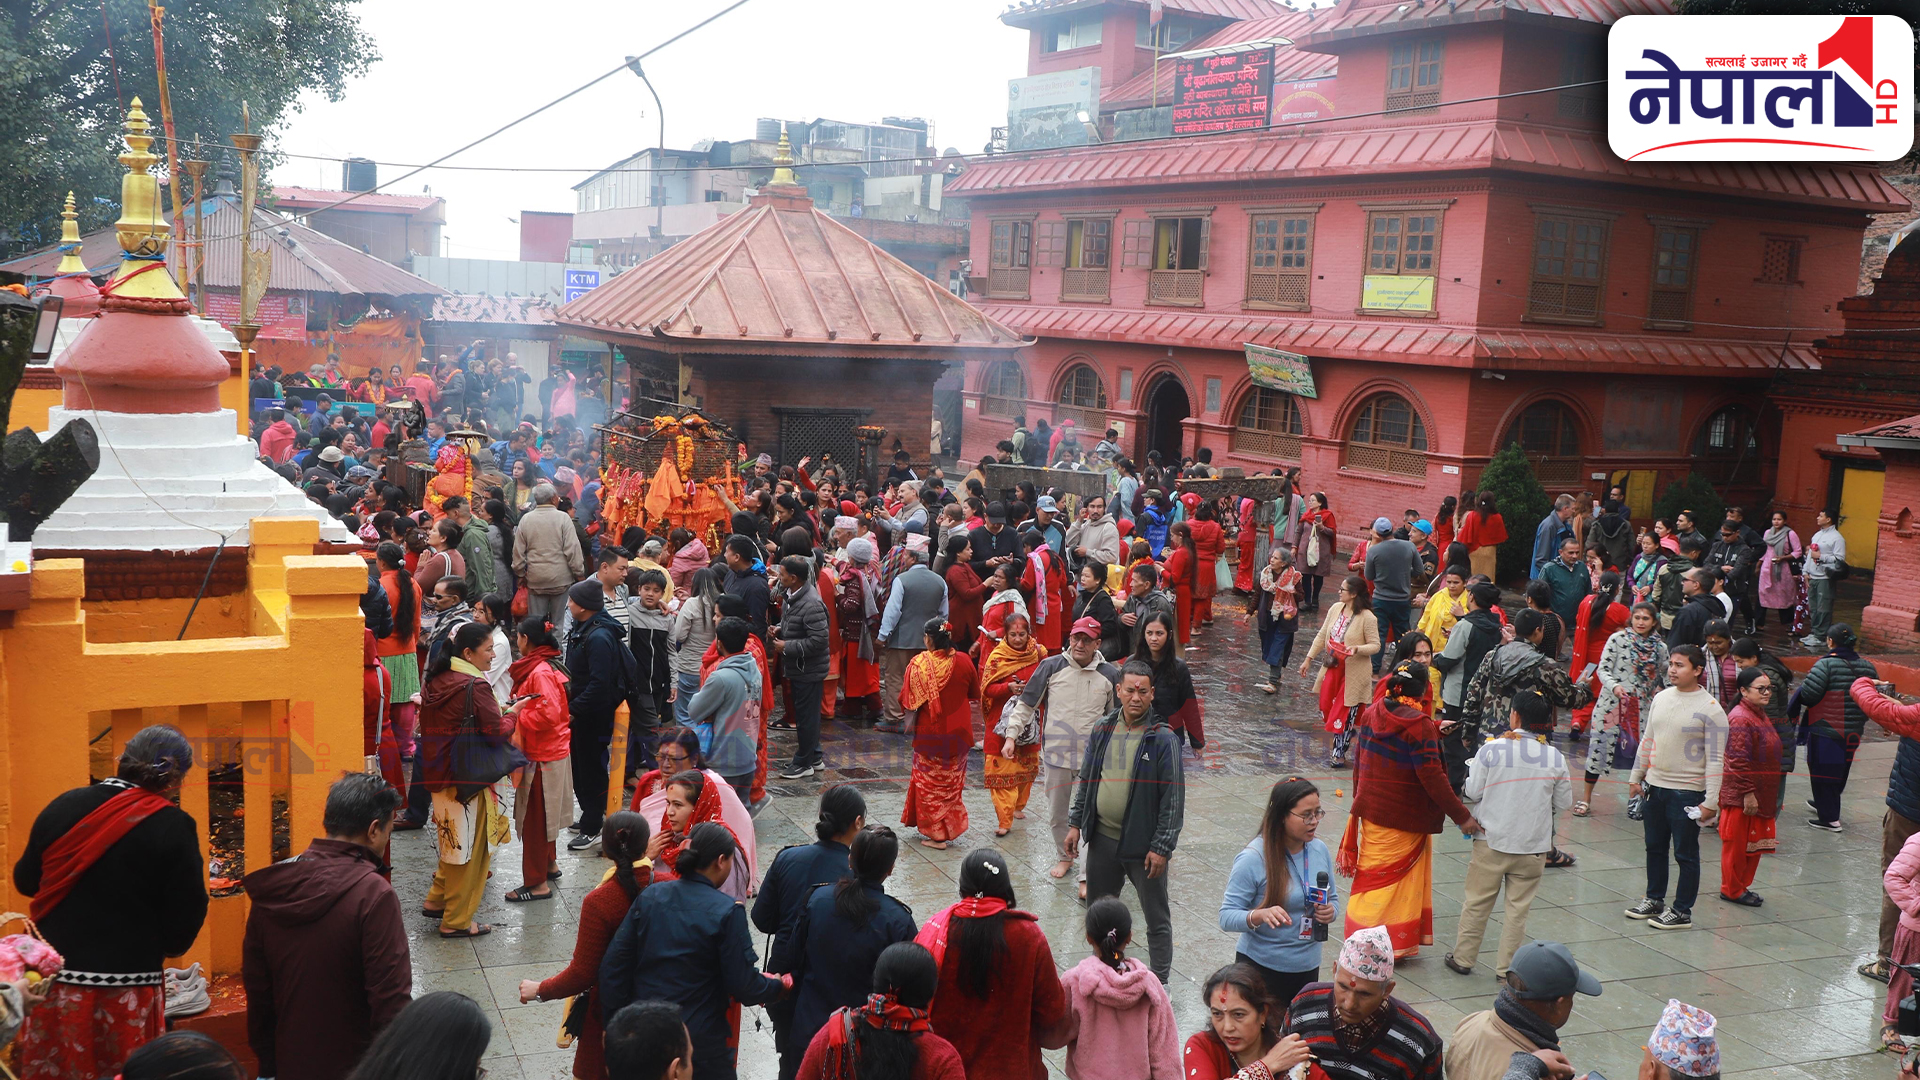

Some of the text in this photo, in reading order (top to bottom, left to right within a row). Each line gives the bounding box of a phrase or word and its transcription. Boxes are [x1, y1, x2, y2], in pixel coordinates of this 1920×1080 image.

[1183, 73, 1193, 87] श्री
[1237, 65, 1259, 81] मन्दिर
[570, 274, 595, 284] KTM
